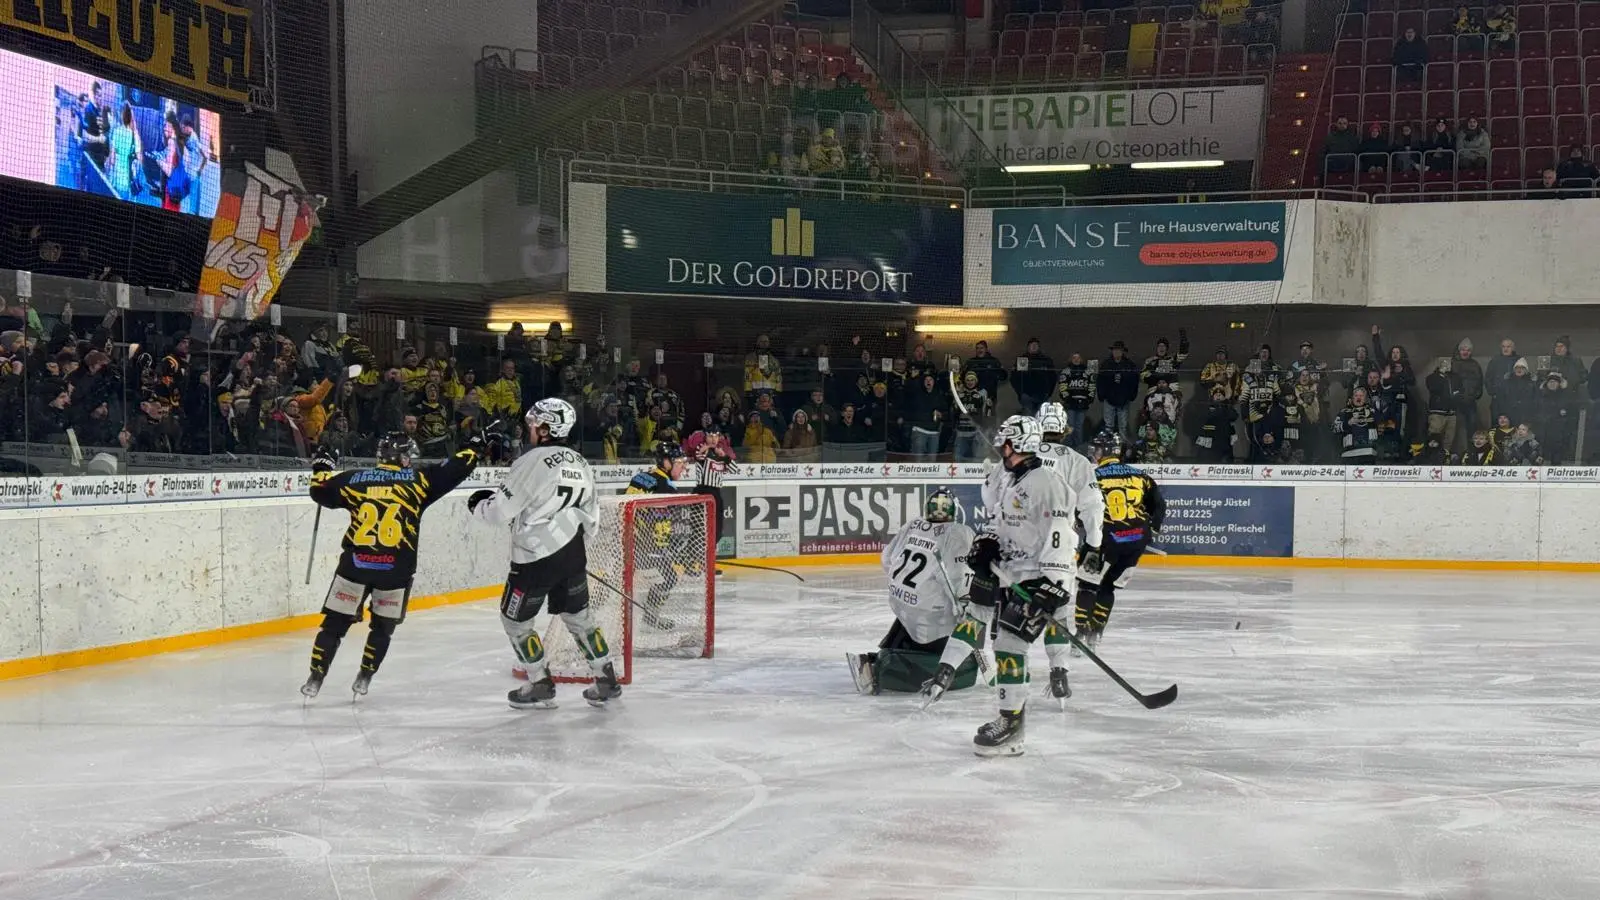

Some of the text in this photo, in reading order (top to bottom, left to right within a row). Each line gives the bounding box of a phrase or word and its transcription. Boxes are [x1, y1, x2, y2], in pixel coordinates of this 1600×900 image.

[933, 90, 1225, 132] THERAPIELOFT
[1095, 136, 1221, 160] Osteopathie
[1140, 218, 1280, 234] Ihre Hausverwaltung
[998, 221, 1131, 249] BANSE
[1023, 259, 1105, 269] OBJEKTVERWALTUNG
[667, 257, 913, 293] DER GOLDREPORT
[561, 469, 583, 481] ROACH
[760, 465, 798, 474] Piotrowski
[820, 465, 874, 475] www.pio-24.de
[898, 465, 940, 473] Piotrowski
[1207, 466, 1253, 475] Piotrowski
[1280, 468, 1345, 477] www.pio-24.de
[1372, 468, 1422, 477] Piotrowski
[1450, 468, 1518, 478] www.pio-24.de
[1547, 467, 1598, 477] Piotrowski
[0, 481, 42, 496] otrowski
[71, 480, 137, 498] www.pio-24.de
[162, 477, 205, 491] Piotrowski
[227, 476, 278, 491] www.pio-24.de
[1195, 497, 1222, 508] Helge
[1224, 497, 1250, 508] Jüstel
[1165, 509, 1213, 518] 921 82225
[353, 502, 402, 547] 26
[1195, 523, 1224, 534] Holger
[1228, 523, 1266, 533] Rieschel
[1052, 531, 1061, 549] 8
[1158, 535, 1180, 544] 0921
[1182, 535, 1228, 544] 150830-0
[892, 549, 928, 589] 72
[1000, 688, 1006, 700] 8
